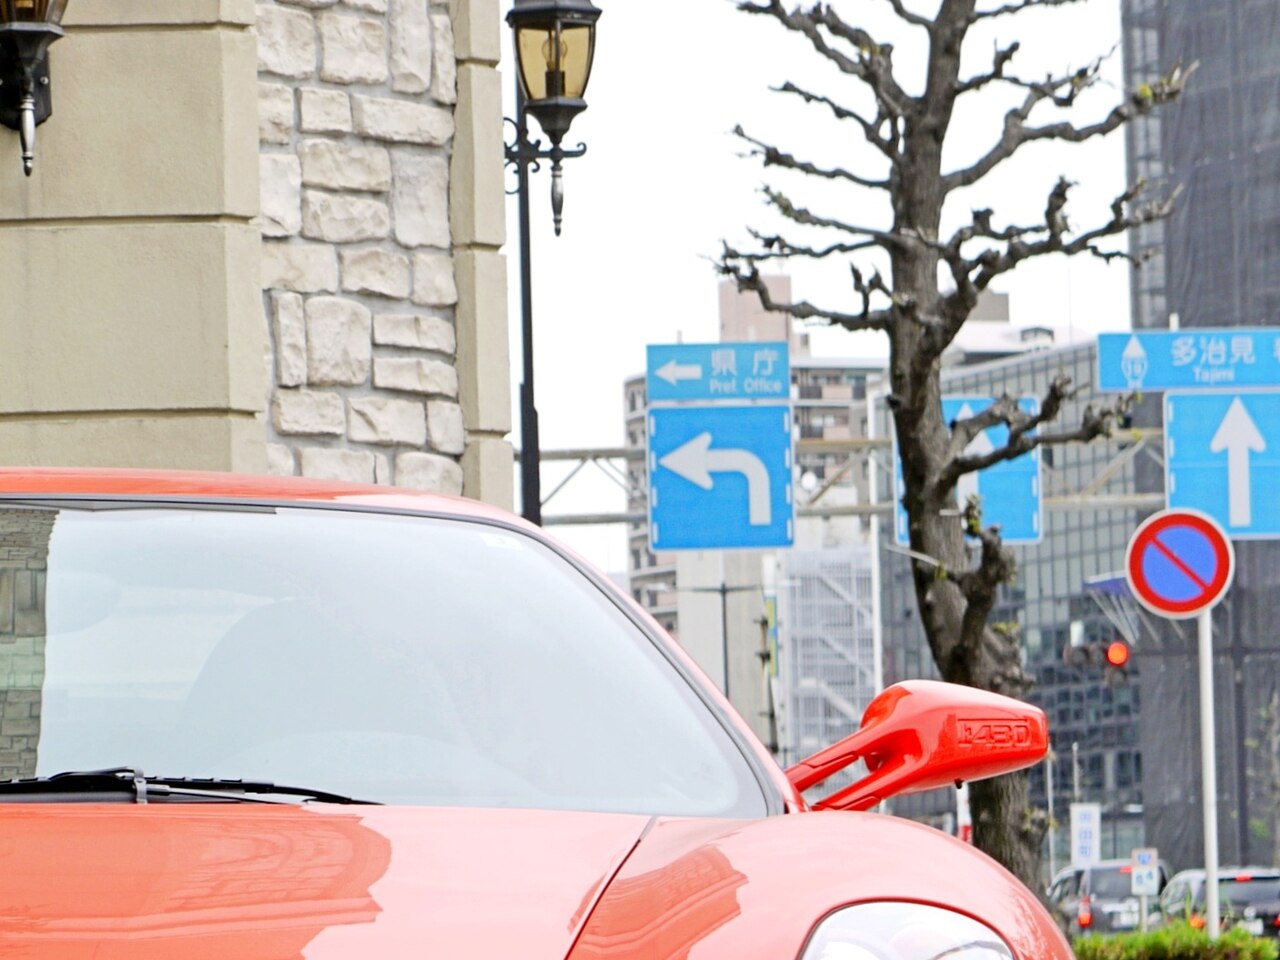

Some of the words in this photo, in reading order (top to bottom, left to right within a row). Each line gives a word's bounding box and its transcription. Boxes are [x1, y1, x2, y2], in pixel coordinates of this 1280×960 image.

[1171, 334, 1255, 367] 多治見
[1193, 367, 1235, 385] Tajimi
[743, 377, 782, 394] Office
